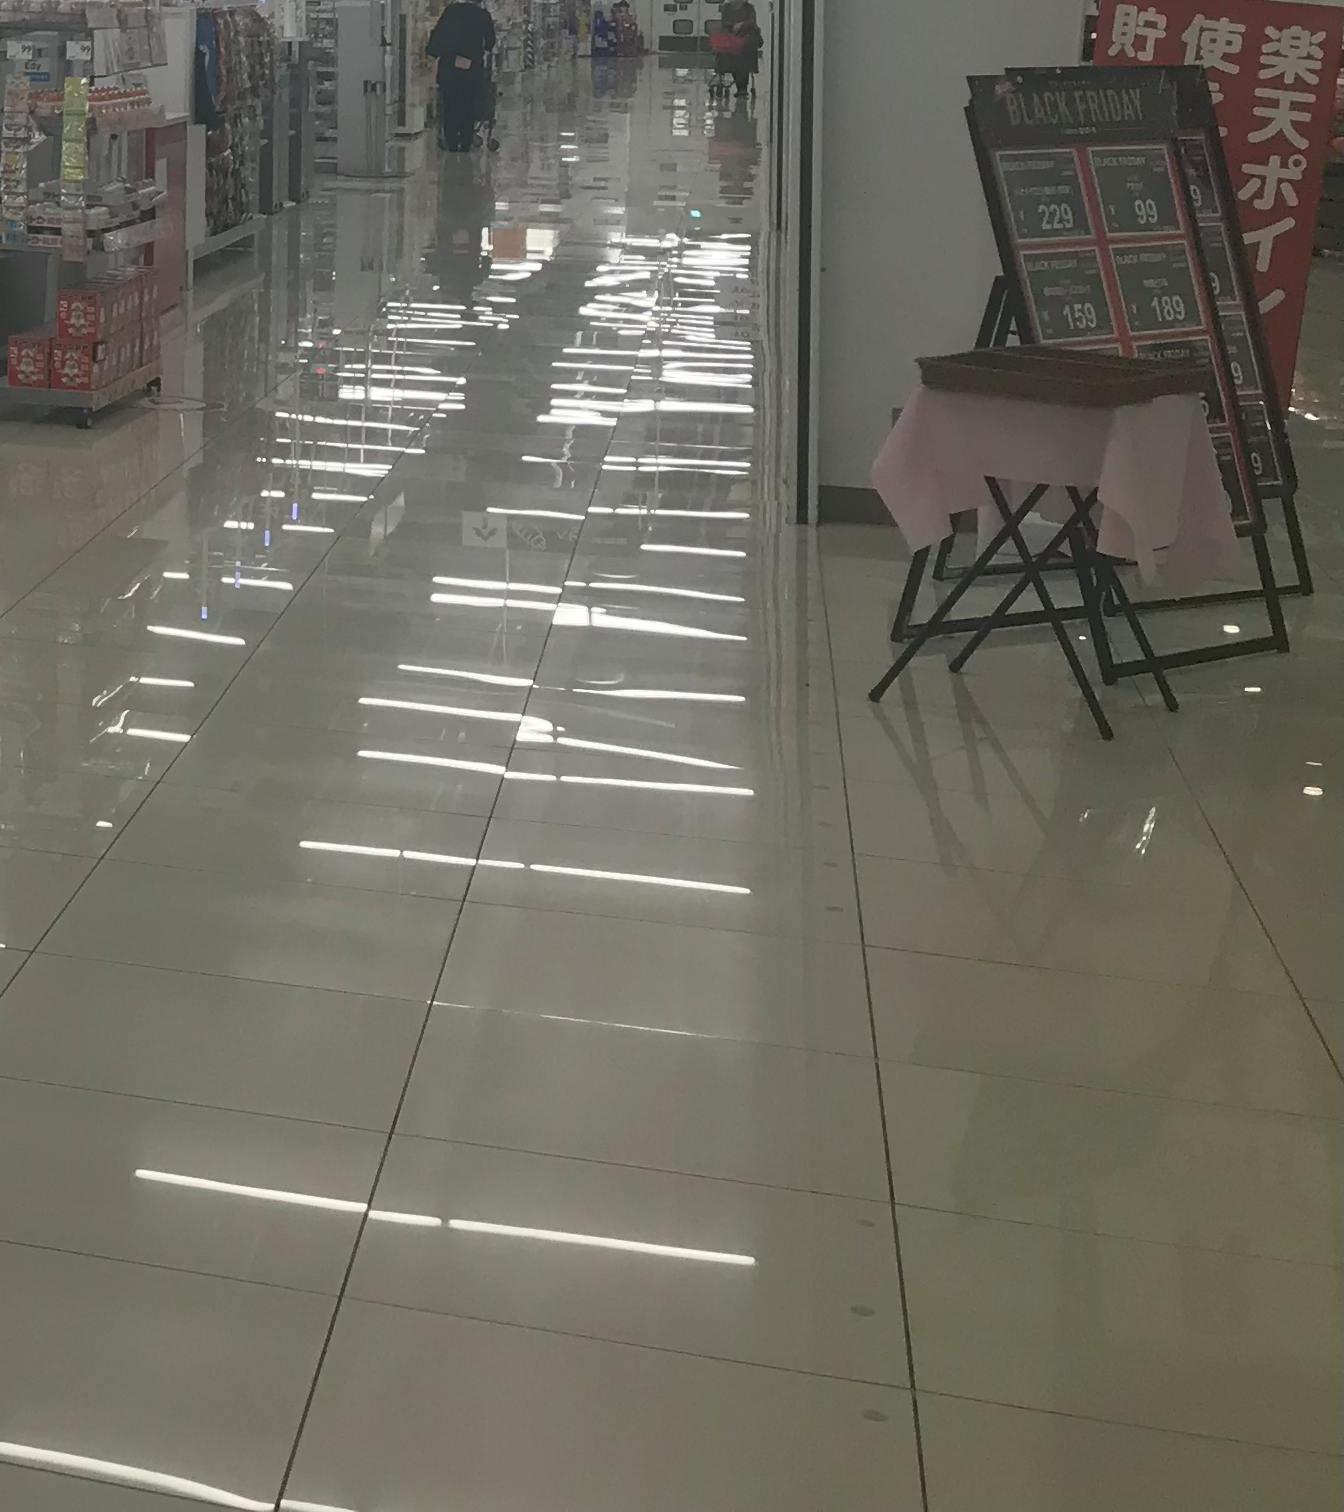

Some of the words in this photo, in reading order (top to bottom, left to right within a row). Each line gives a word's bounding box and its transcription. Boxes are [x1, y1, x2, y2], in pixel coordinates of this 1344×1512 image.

[1006, 90, 1073, 126] BLACK
[1075, 88, 1144, 124] FRIDAY
[1037, 203, 1074, 230] 229
[1134, 198, 1159, 224] 99
[1063, 303, 1097, 330] 159
[1150, 295, 1185, 322] 189
